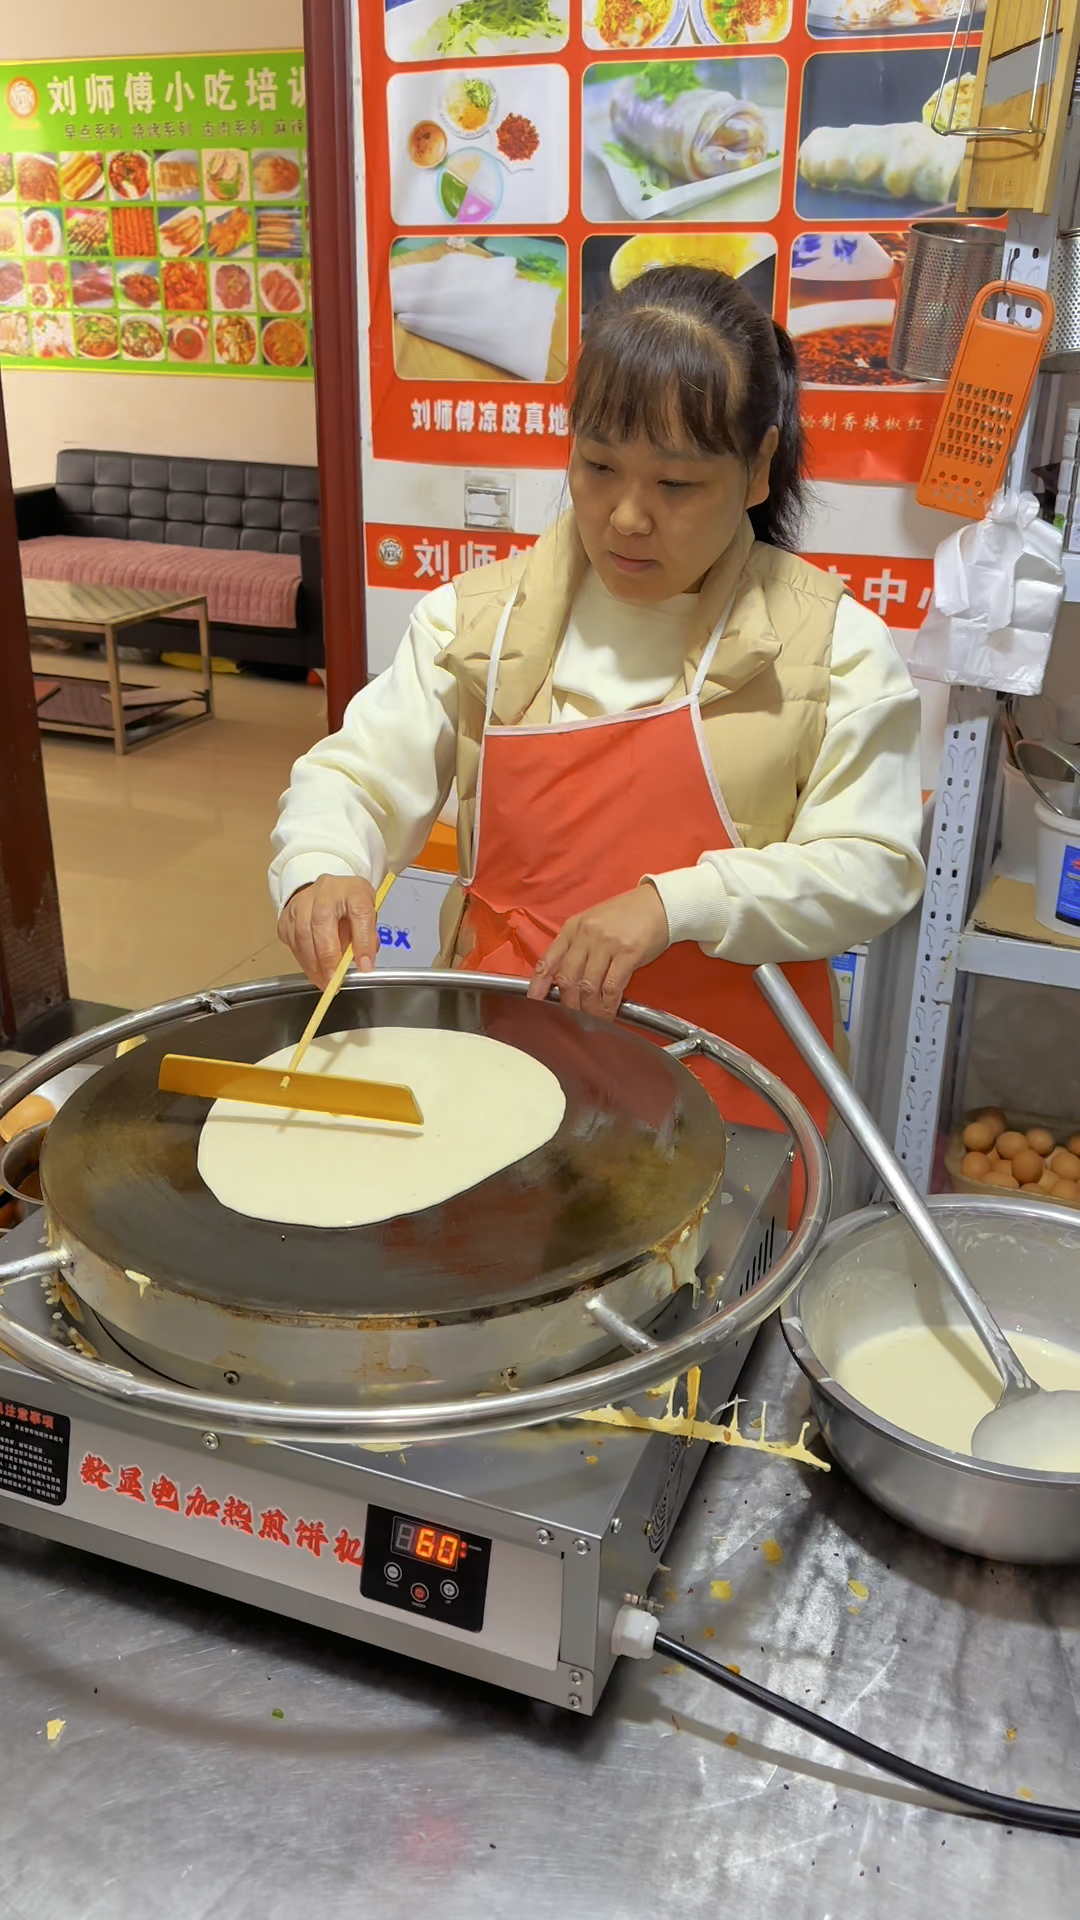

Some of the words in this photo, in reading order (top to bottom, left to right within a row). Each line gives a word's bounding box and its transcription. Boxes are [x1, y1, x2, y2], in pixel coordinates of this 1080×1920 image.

[410, 398, 569, 436] 刘师傅凉皮真地
[79, 1453, 364, 1567] 数显电加热煎饼机
[416, 1528, 458, 1565] 60
